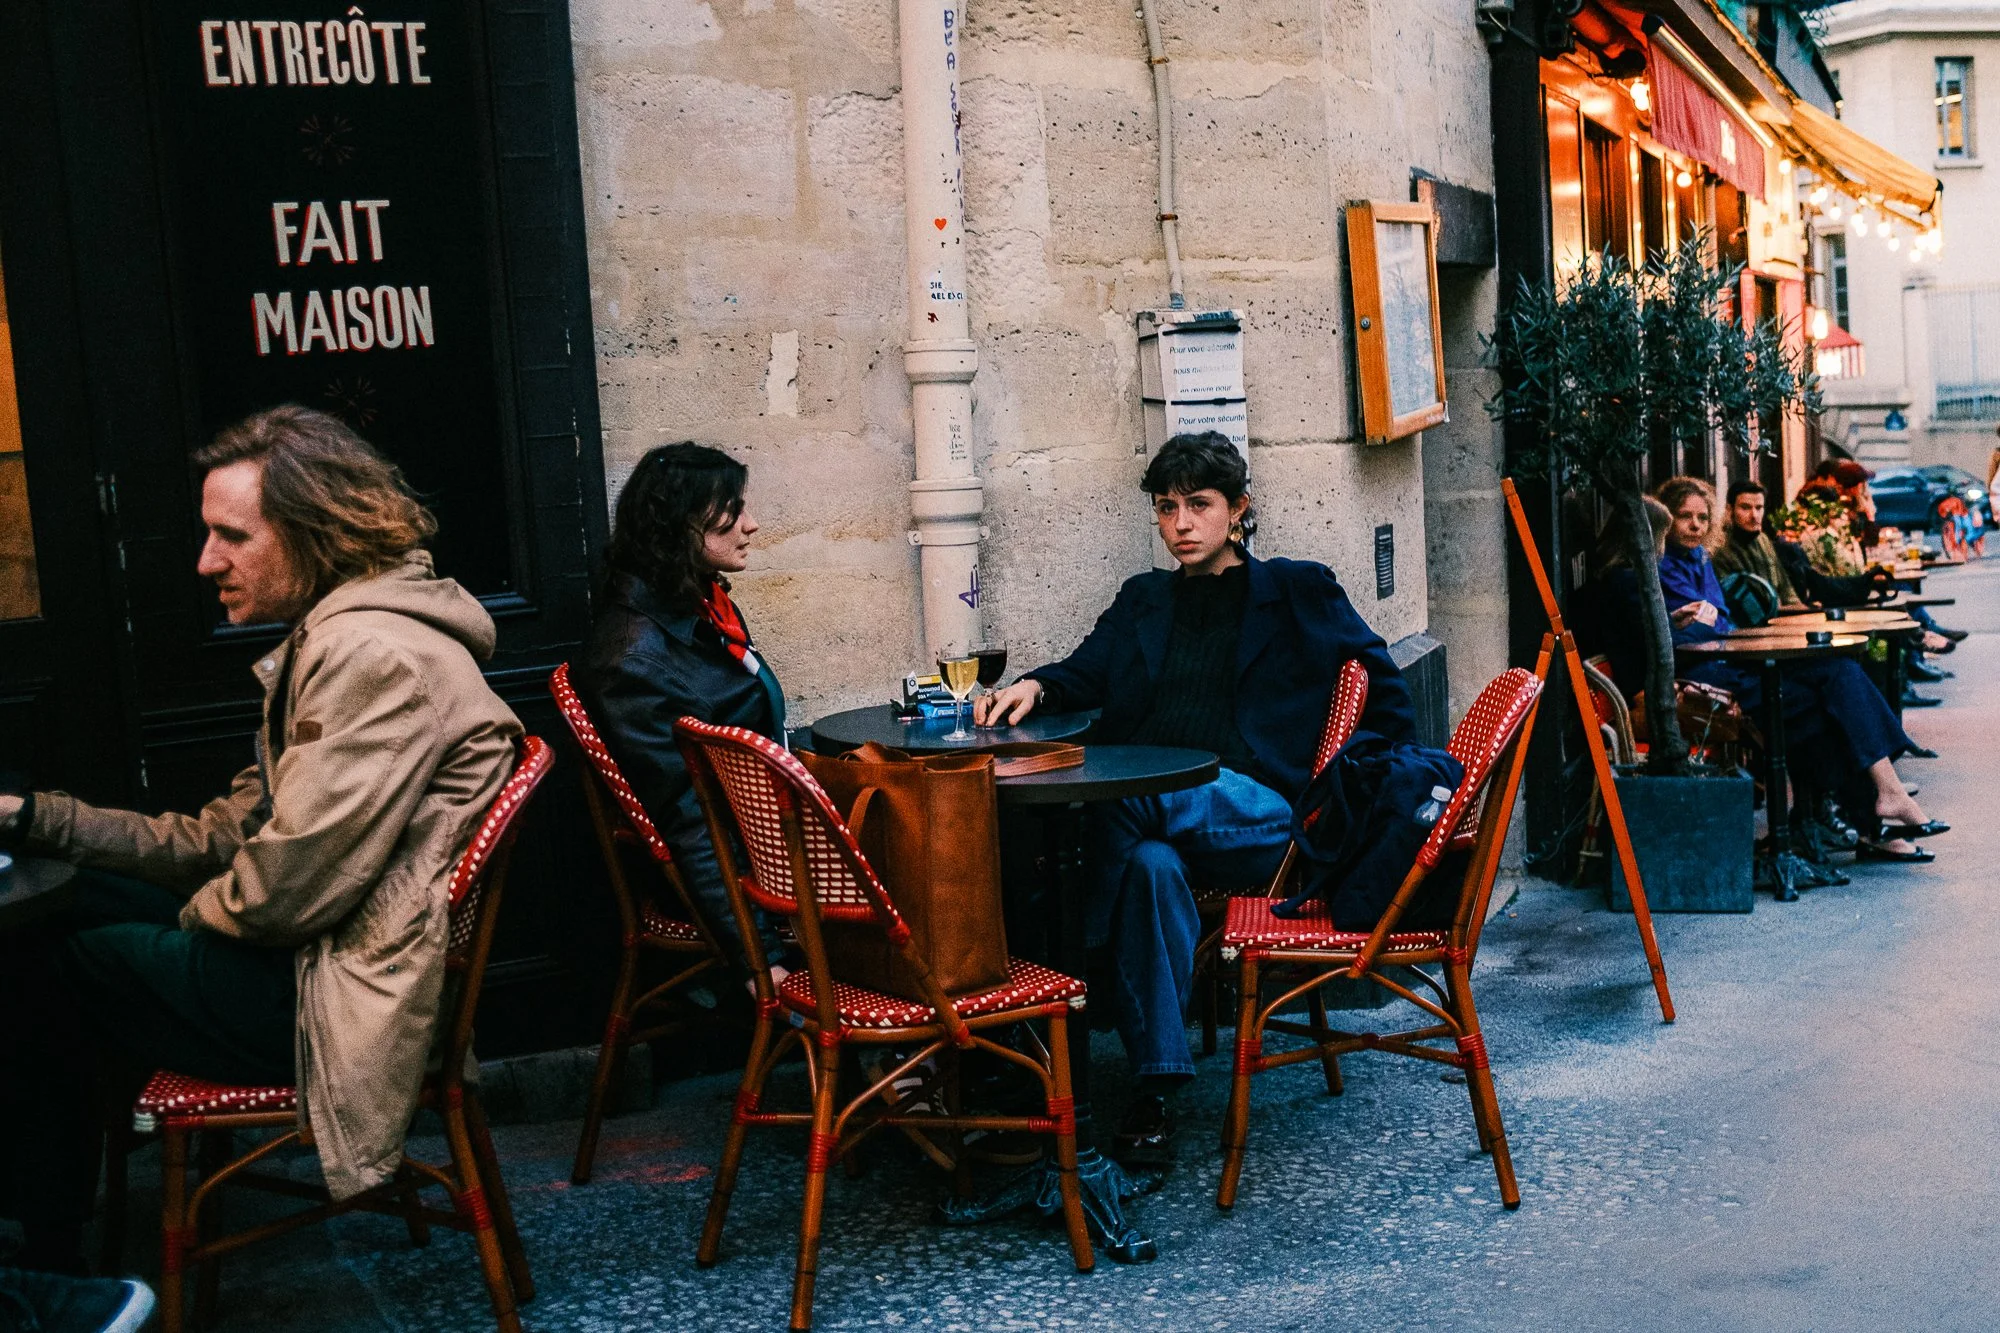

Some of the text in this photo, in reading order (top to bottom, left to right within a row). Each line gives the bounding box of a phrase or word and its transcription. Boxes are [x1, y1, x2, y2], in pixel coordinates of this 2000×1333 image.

[199, 6, 431, 87] ENTRECÔTE
[272, 199, 390, 266] FAIT
[251, 285, 435, 356] MAISON
[1169, 346, 1186, 354] Pour
[1173, 367, 1191, 375] nous
[1178, 417, 1197, 425] Pour
[1197, 416, 1216, 424] votre
[1231, 434, 1246, 442] tout
